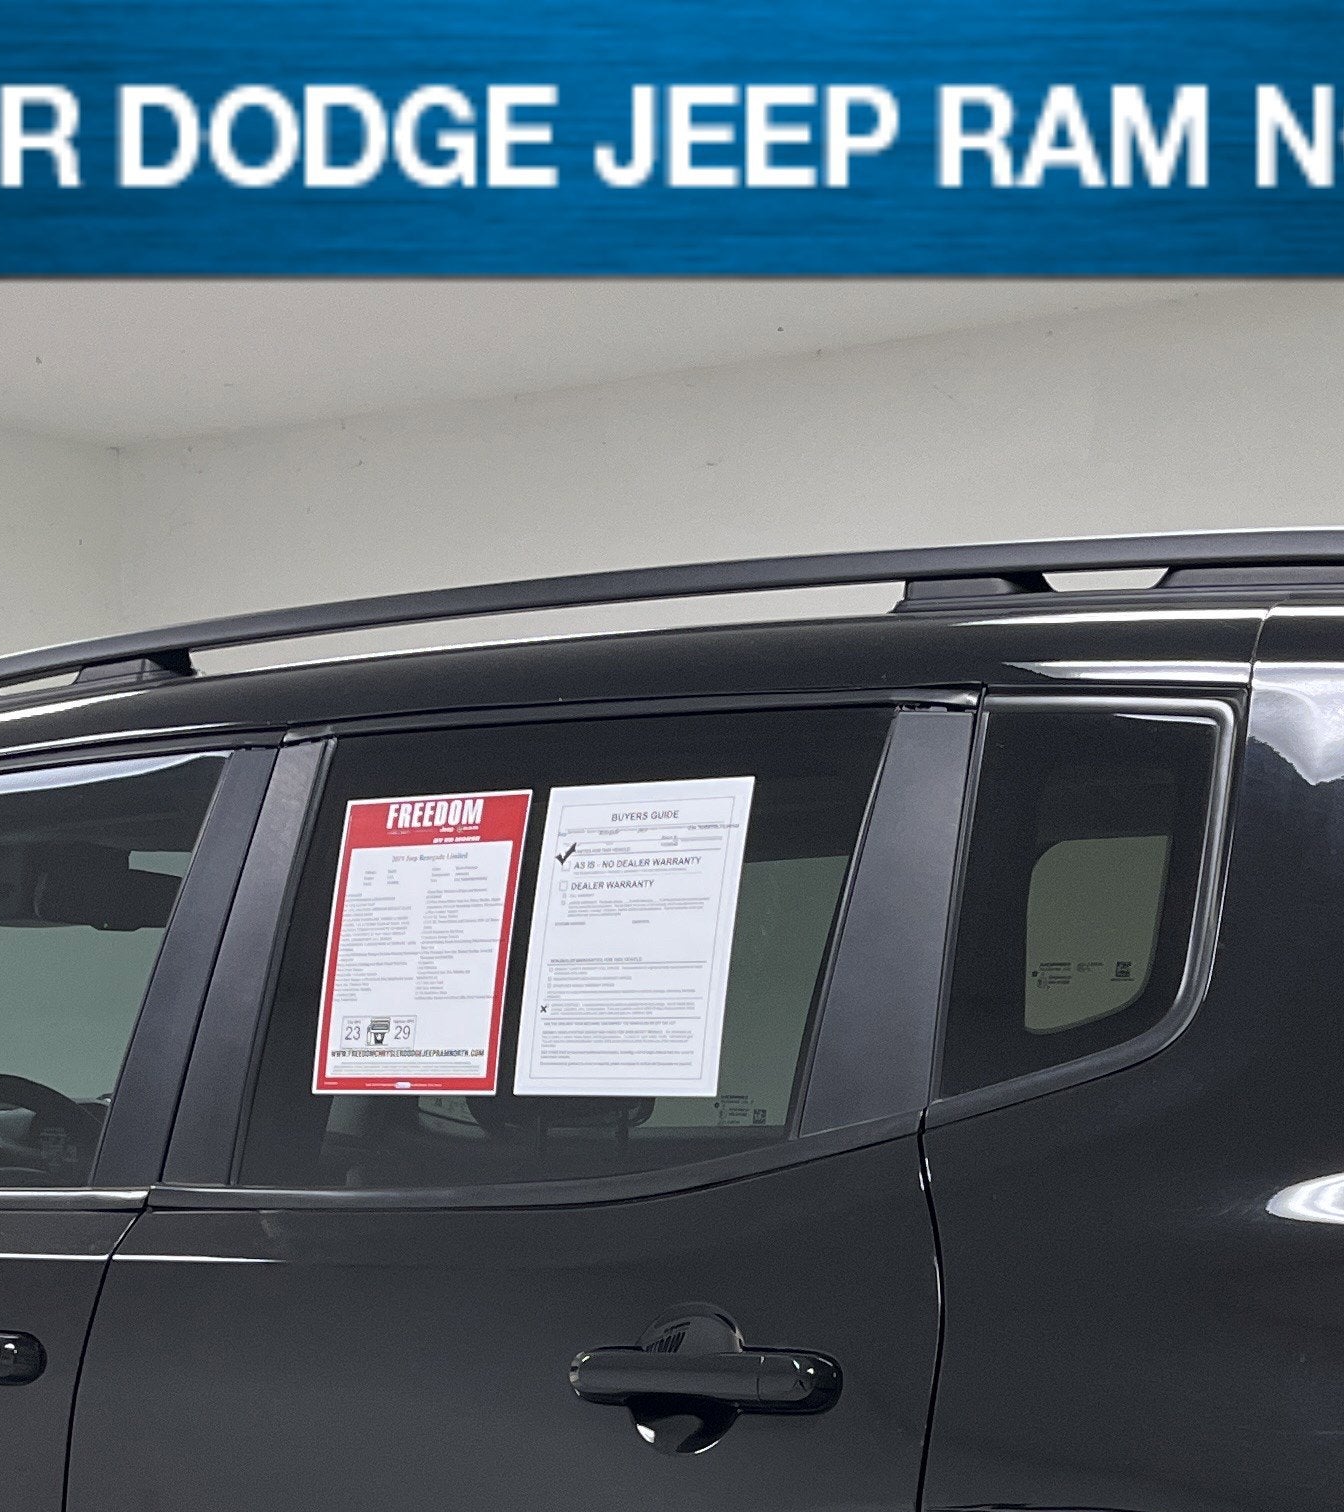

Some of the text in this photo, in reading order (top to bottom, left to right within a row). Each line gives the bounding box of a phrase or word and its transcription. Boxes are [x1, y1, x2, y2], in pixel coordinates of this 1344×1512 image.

[386, 799, 484, 829] FREEDOM
[611, 810, 680, 822] BUYERS GUIDE
[573, 861, 586, 870] AS
[587, 861, 596, 869] IS
[602, 859, 615, 868] NO
[616, 858, 650, 868] DEALER
[652, 857, 702, 867] WARRANTY
[570, 880, 655, 891] DEALER WARRANTY
[344, 1025, 411, 1041] 23 29
